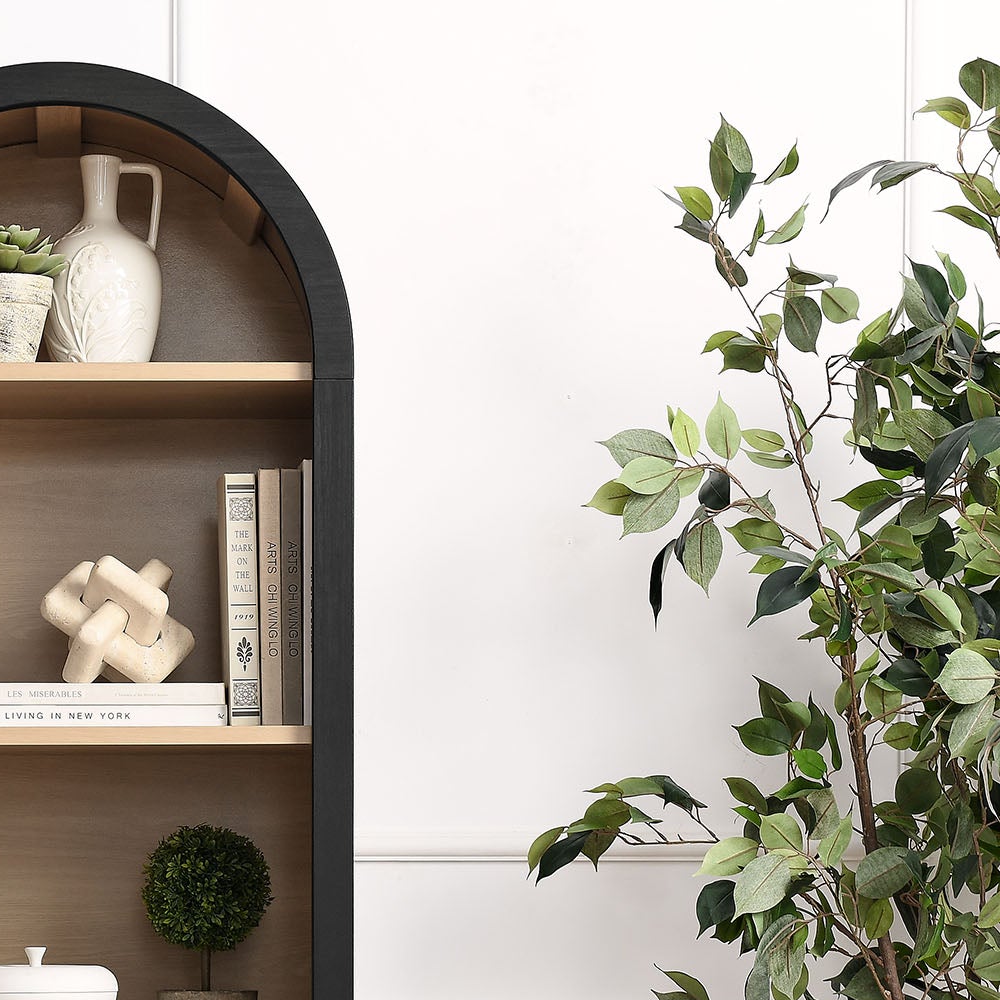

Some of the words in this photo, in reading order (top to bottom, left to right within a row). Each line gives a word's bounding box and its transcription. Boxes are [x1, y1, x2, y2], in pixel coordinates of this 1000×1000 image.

[234, 530, 249, 539] THE
[231, 543, 253, 552] MARK
[236, 557, 248, 566] ON
[266, 541, 277, 574] ARTS
[287, 541, 298, 574] ARTS
[235, 571, 250, 579] THE
[232, 584, 253, 593] WALL
[267, 584, 278, 604] CHI
[288, 584, 298, 604] CHI
[268, 607, 279, 639] WING
[288, 607, 299, 639] WING
[268, 642, 279, 657] LO
[289, 642, 299, 657] LO
[7, 690, 23, 698] LES
[28, 690, 82, 698] MISERABLES
[4, 712, 44, 720] LIVING
[50, 712, 62, 720] IN
[68, 712, 93, 720] NEW
[99, 712, 131, 720] YORK
